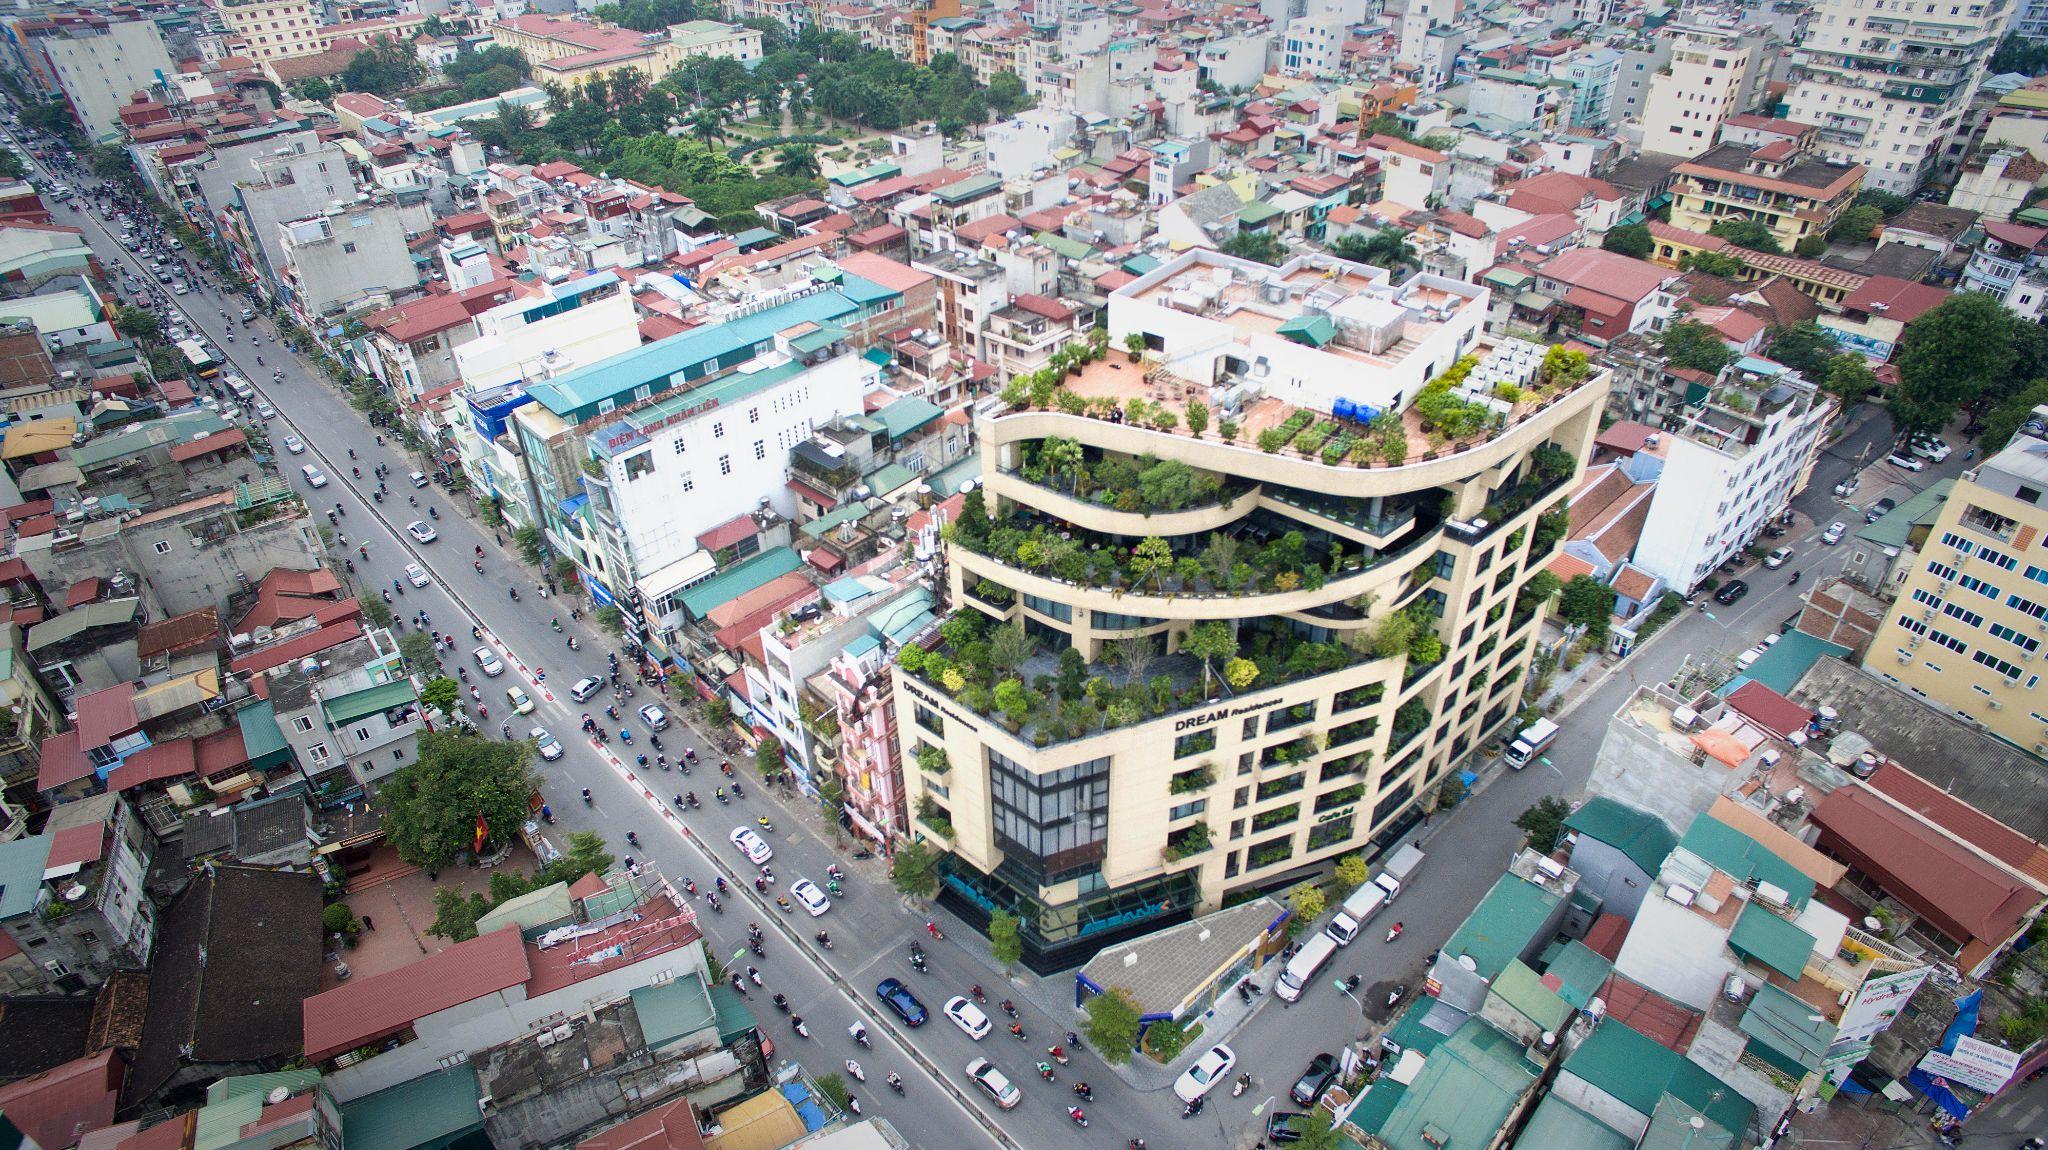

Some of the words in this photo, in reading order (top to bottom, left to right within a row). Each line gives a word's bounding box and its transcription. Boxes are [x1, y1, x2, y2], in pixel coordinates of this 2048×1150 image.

[903, 681, 939, 708] DREAM
[1175, 709, 1229, 731] DREAM
[1231, 698, 1284, 716] Residences
